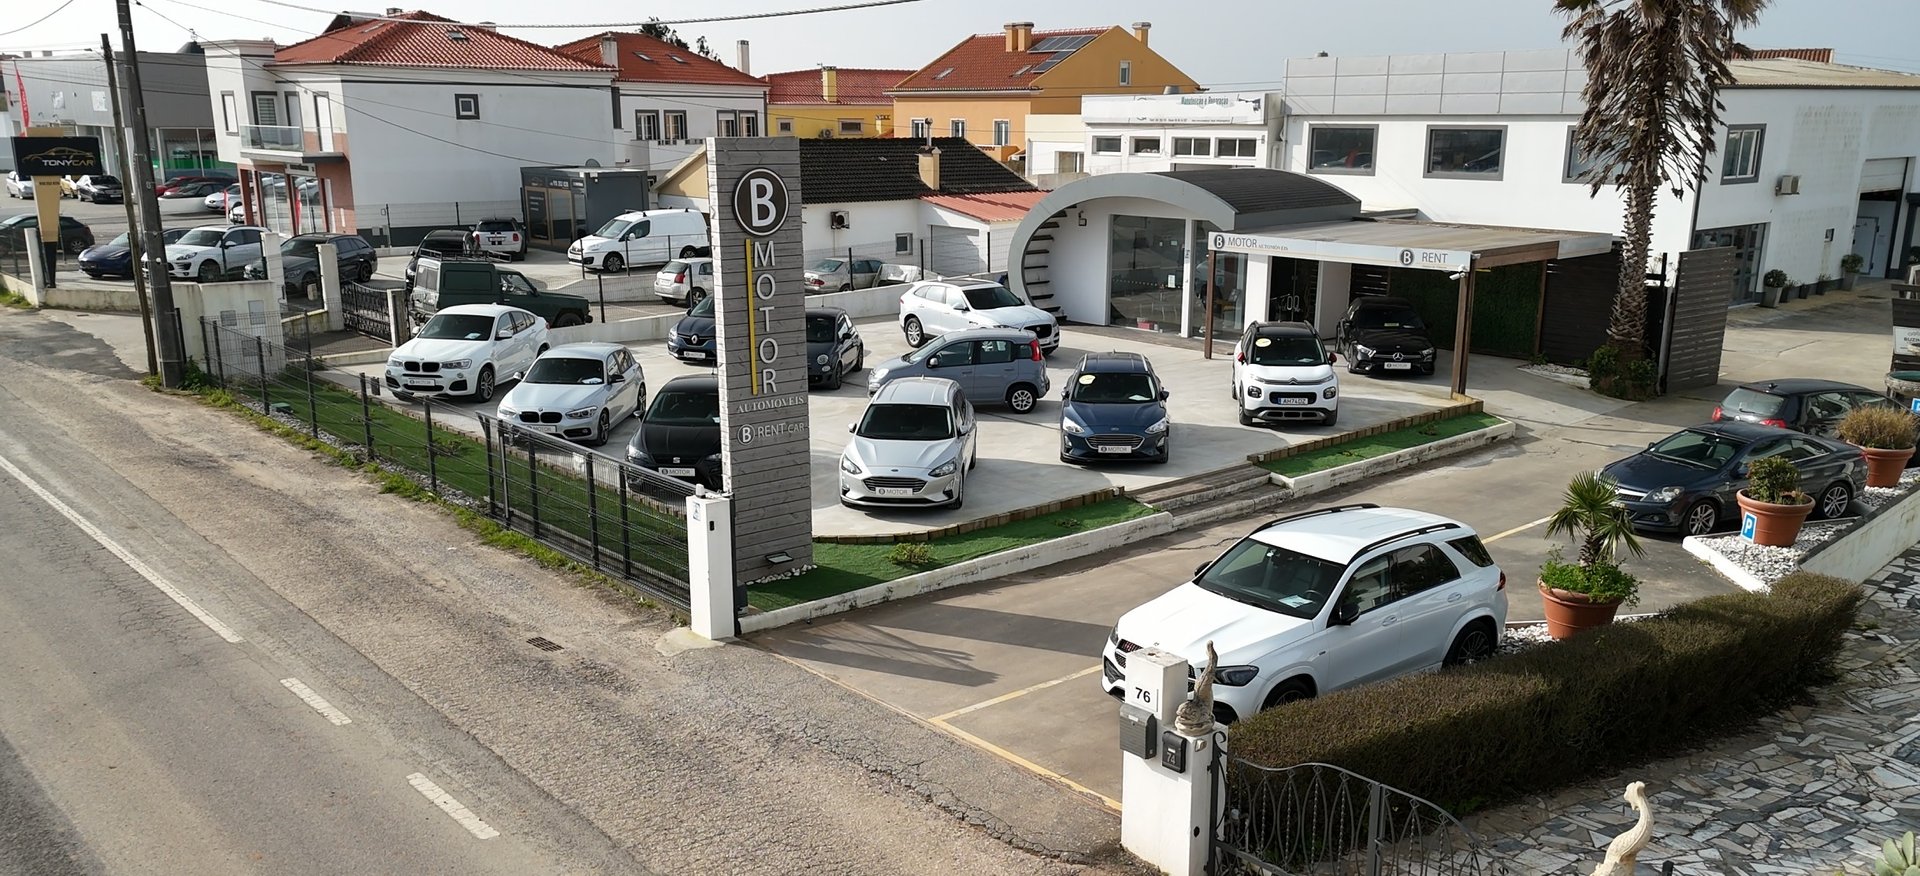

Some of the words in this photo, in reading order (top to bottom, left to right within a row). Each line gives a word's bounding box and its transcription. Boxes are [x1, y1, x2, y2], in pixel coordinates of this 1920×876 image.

[750, 178, 776, 226] B
[1215, 236, 1224, 249] B
[1228, 237, 1257, 248] MOTOR
[1402, 251, 1411, 264] B
[1421, 252, 1448, 263] RENT
[754, 241, 778, 394] MOTOR
[742, 427, 752, 443] B
[757, 422, 786, 438] RENT
[787, 423, 805, 433] CAR
[1744, 517, 1753, 534] P
[1135, 686, 1151, 703] 76
[1166, 751, 1176, 765] 74
